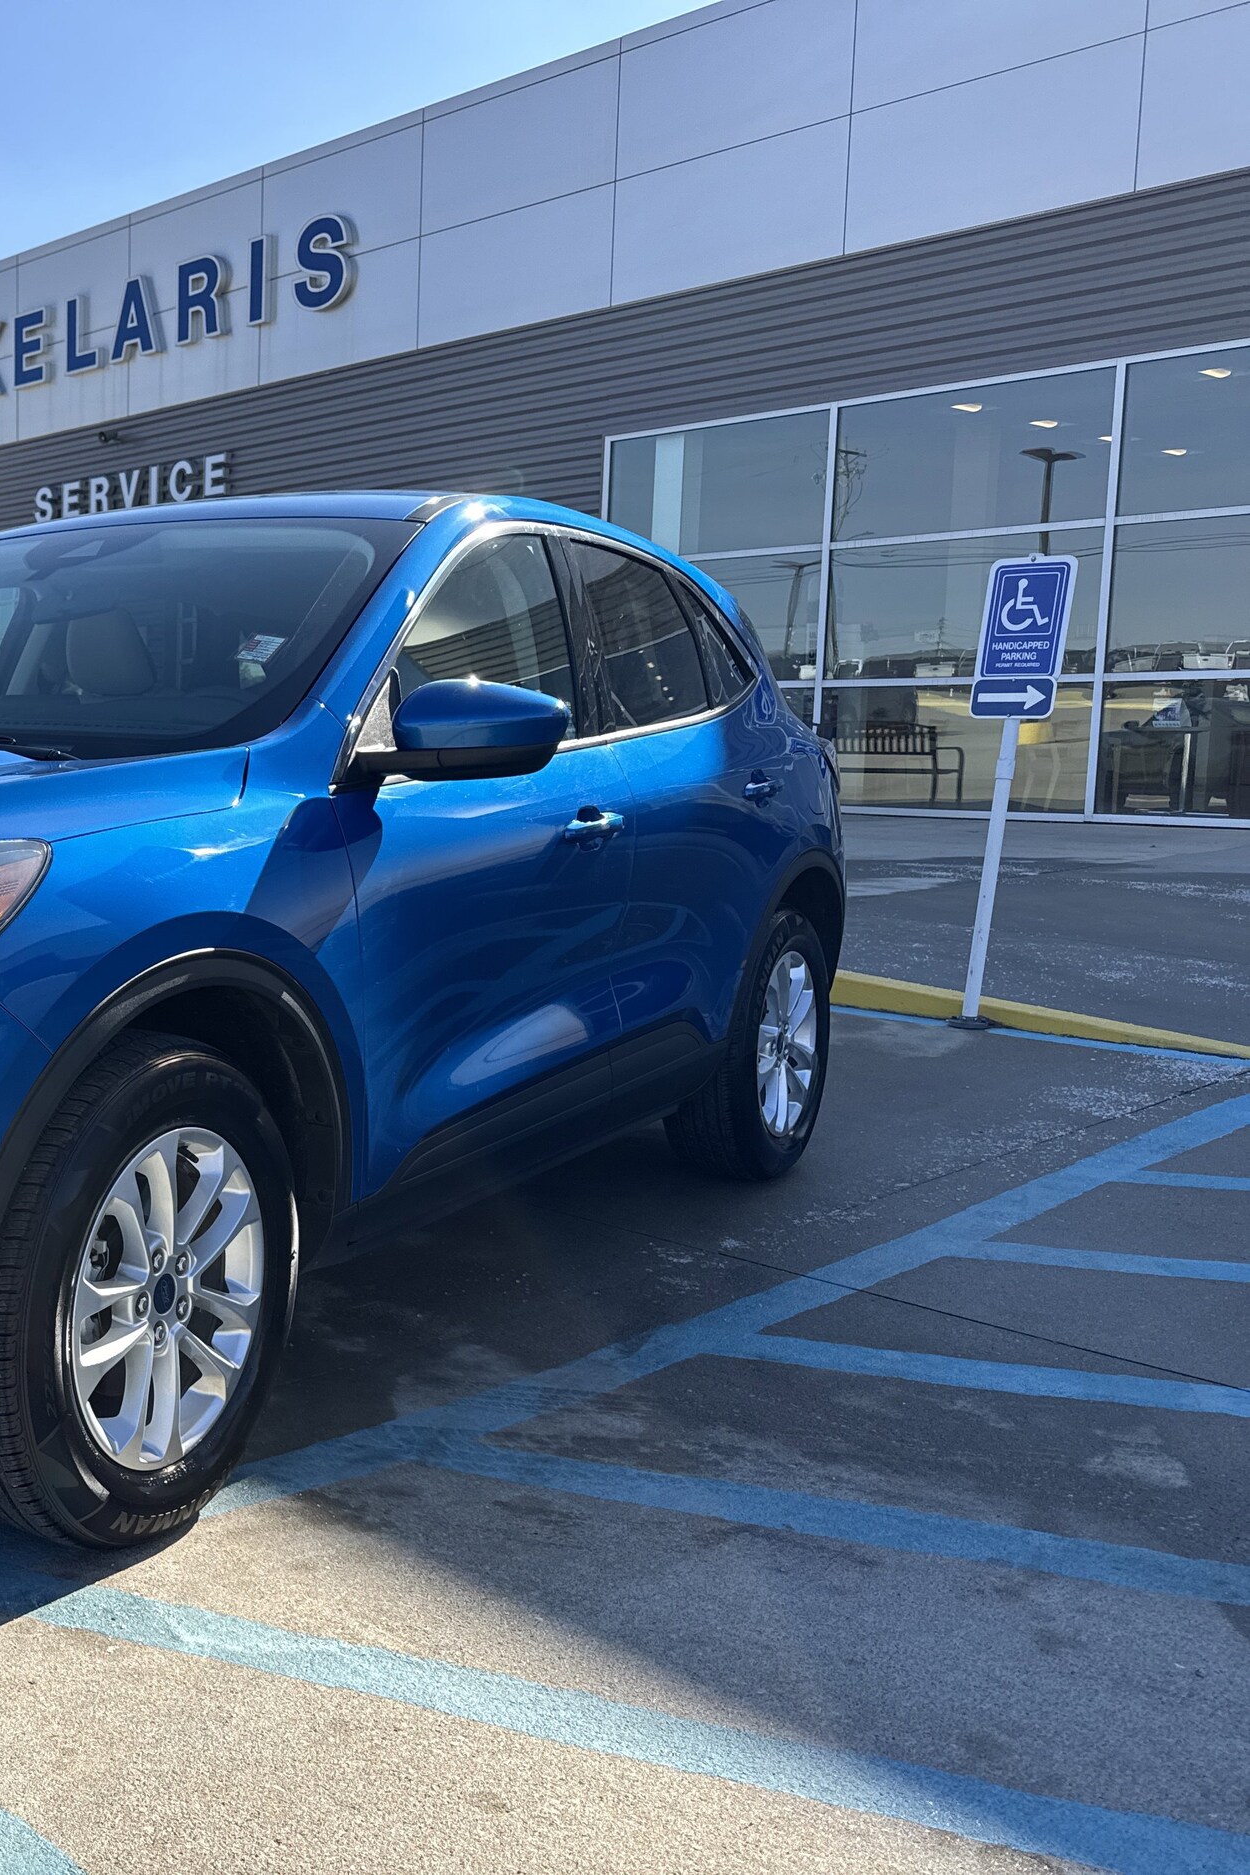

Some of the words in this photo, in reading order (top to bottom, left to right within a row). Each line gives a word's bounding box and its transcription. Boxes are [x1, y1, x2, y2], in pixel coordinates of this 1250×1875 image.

[34, 452, 231, 523] SERVICE
[992, 641, 1050, 651] HANDICAPPED
[1001, 652, 1037, 661] PARKING
